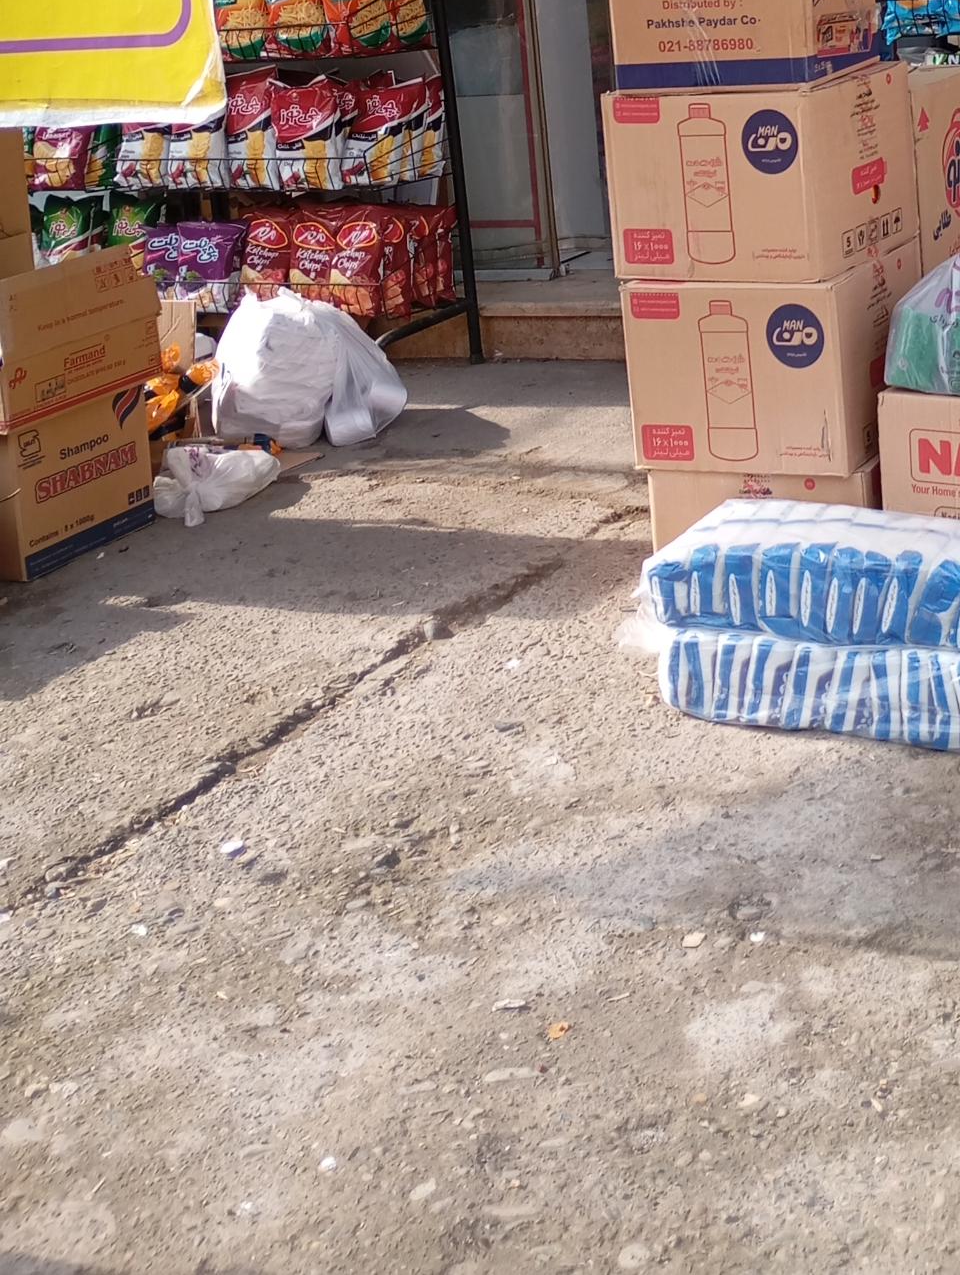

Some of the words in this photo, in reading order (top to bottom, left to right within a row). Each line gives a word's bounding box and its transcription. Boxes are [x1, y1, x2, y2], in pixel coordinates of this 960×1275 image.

[662, 0, 720, 10] Distributed
[698, 16, 738, 29] Paydar
[757, 125, 778, 137] MAN
[782, 320, 803, 331] MAN
[64, 345, 106, 367] Farmand
[60, 434, 109, 460] Shampoo
[35, 441, 137, 503] SHABNAM
[911, 484, 930, 495] Your
